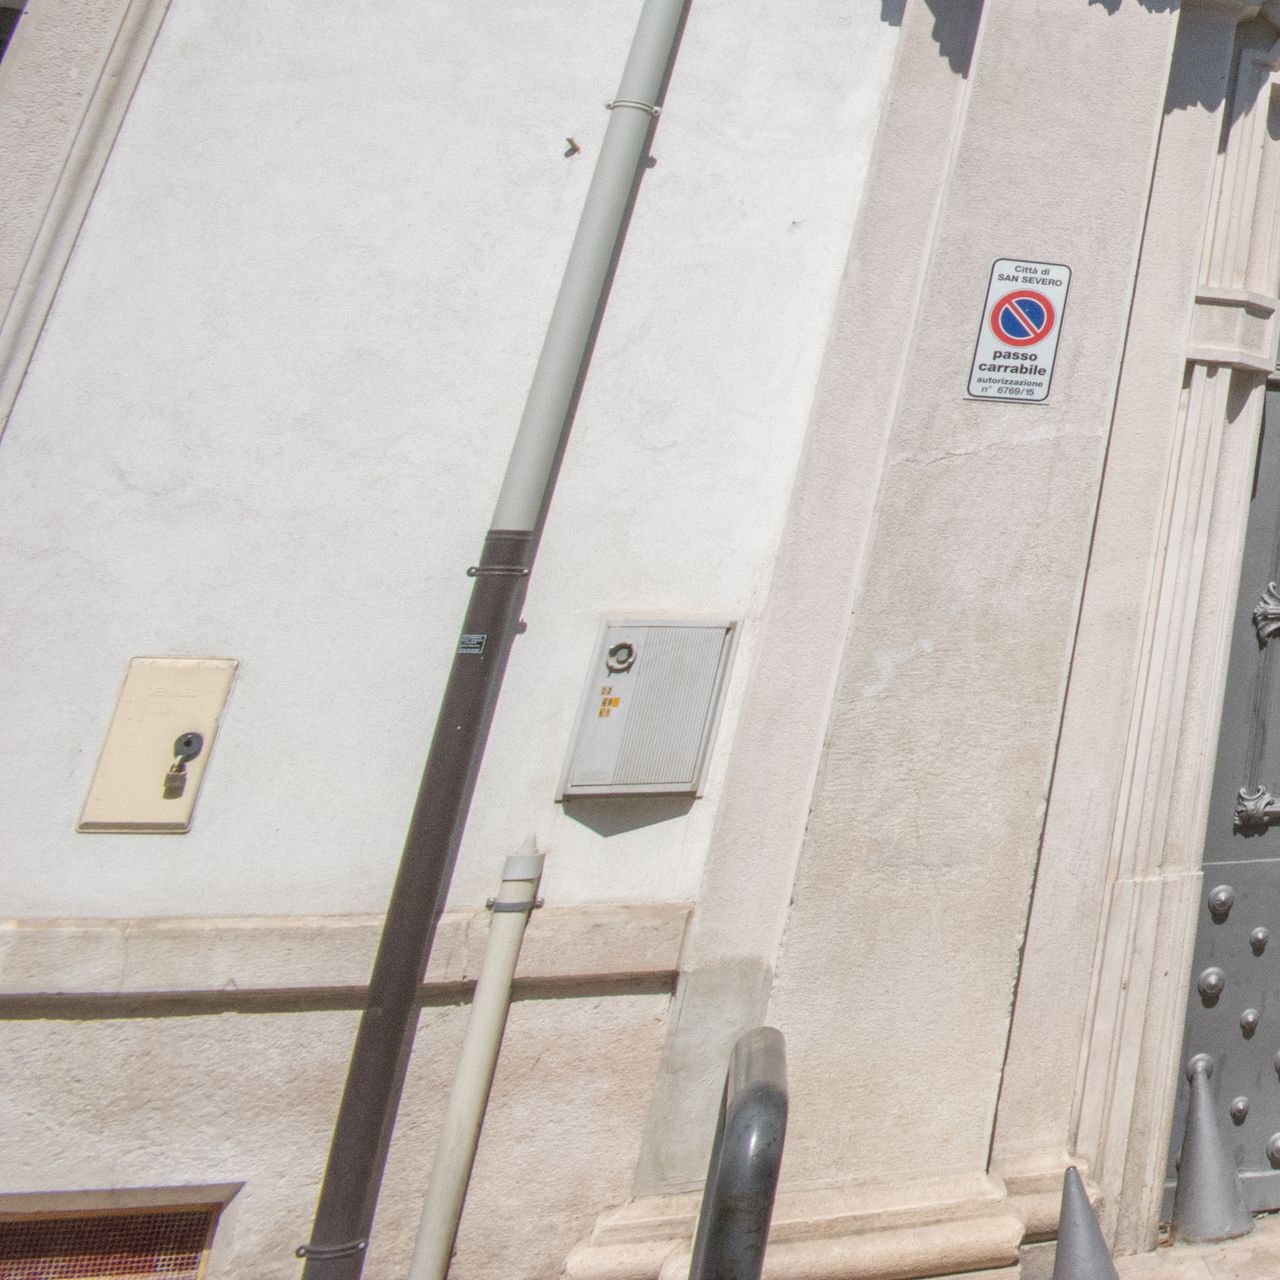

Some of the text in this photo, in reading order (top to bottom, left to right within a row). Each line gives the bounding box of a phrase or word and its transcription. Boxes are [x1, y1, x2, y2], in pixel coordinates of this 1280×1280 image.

[1015, 265, 1050, 276] Città di
[998, 273, 1062, 287] SAN SEVERO
[993, 350, 1038, 361] passo
[979, 363, 1047, 376] carrabile
[976, 377, 1043, 388] autorizzazione
